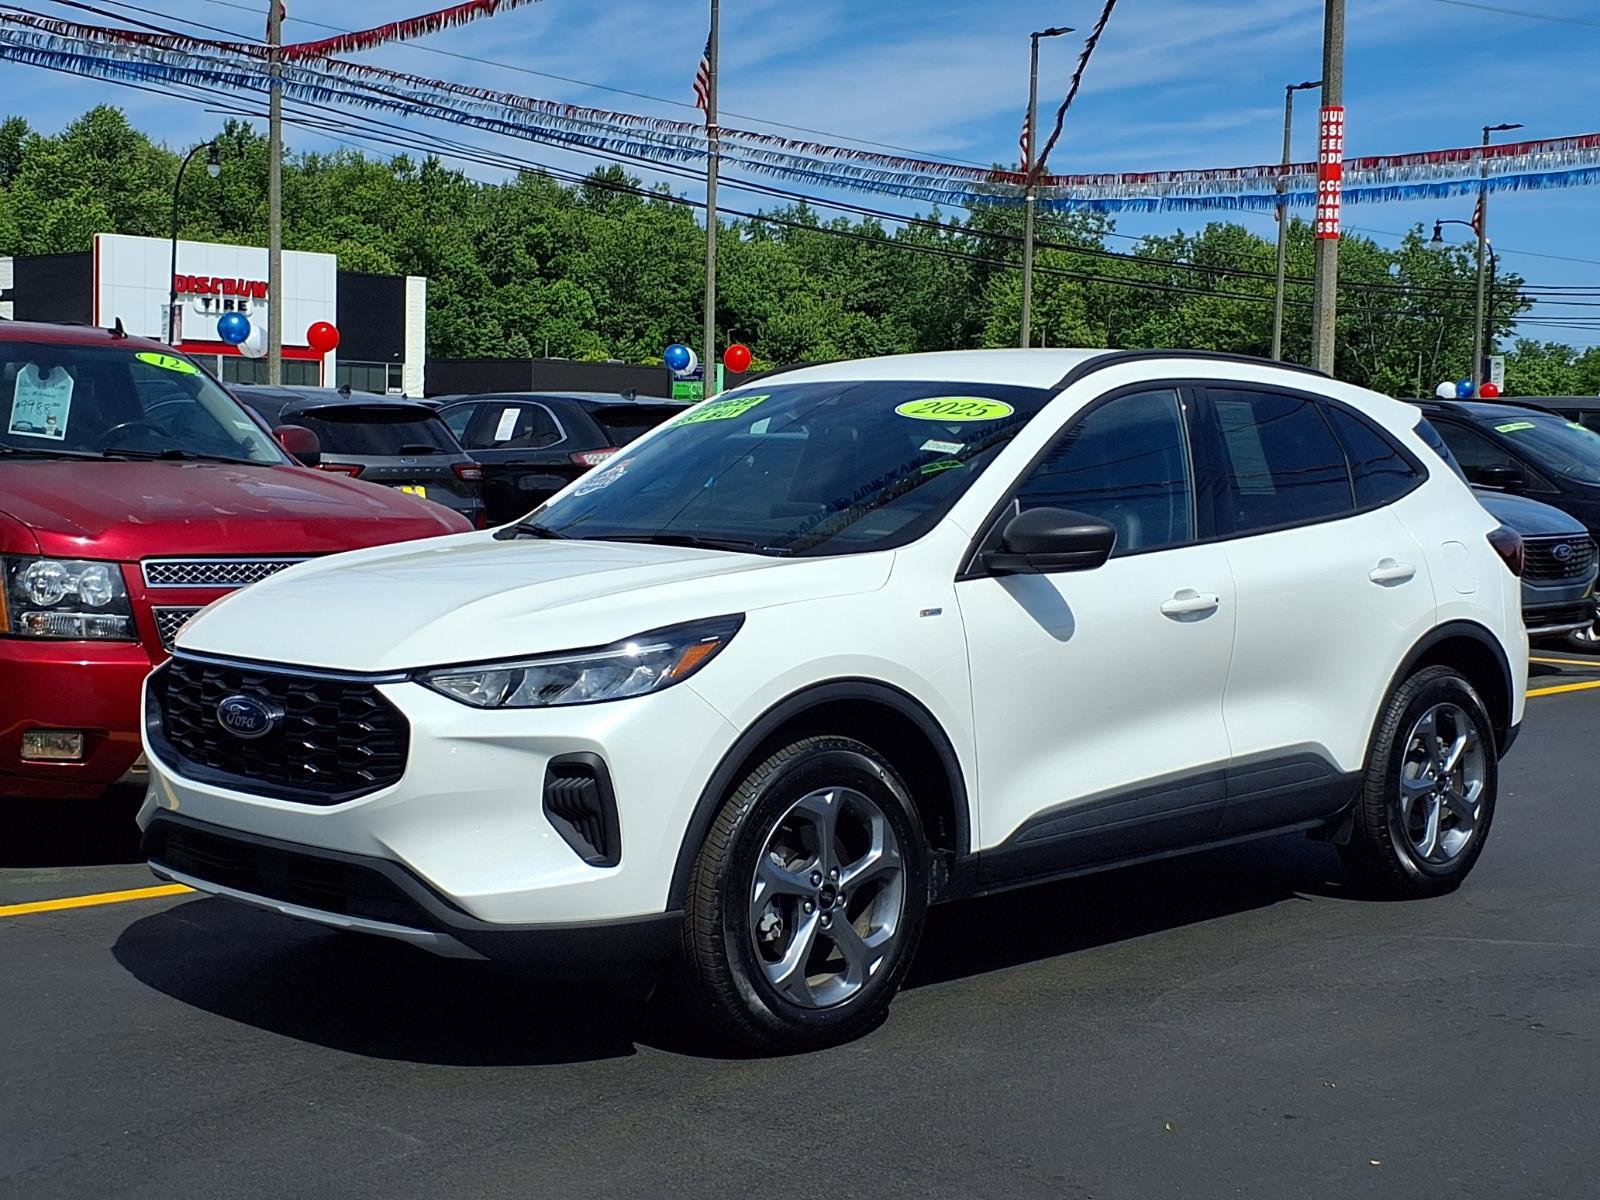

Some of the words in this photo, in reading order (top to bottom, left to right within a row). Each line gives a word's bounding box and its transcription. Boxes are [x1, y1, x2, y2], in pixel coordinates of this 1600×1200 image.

[175, 275, 269, 298] DISCOUN
[202, 298, 248, 312] TIRE
[159, 356, 181, 369] 12
[911, 401, 998, 417] 2025
[225, 703, 257, 728] Ford
